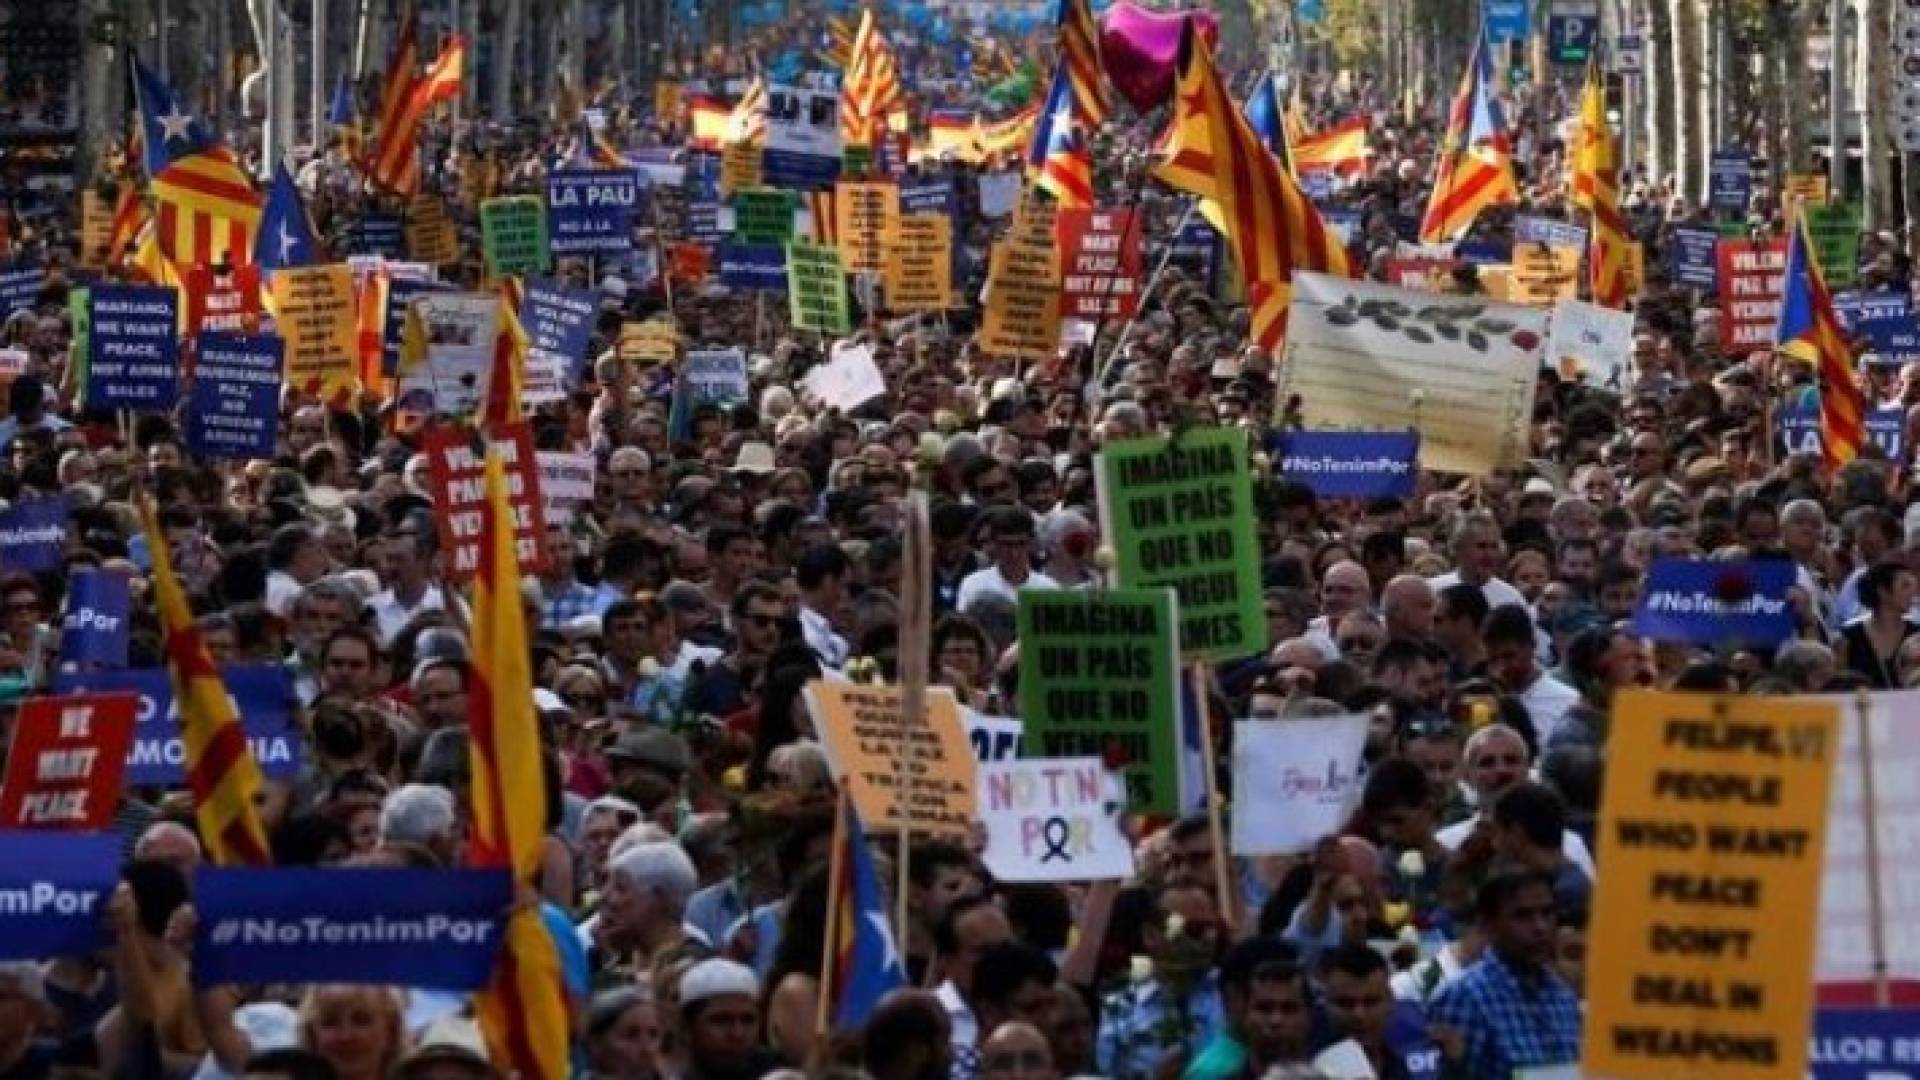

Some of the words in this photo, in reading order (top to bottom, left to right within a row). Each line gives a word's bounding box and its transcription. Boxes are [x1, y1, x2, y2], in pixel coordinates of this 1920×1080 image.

[551, 184, 579, 206] LA
[587, 184, 636, 205] PAU
[96, 321, 119, 335] WE
[123, 321, 170, 336] WANT
[1119, 442, 1236, 488] IMAGINA
[1281, 455, 1410, 474] #NoTenimPor
[1130, 494, 1169, 532] UN
[1172, 480, 1234, 525] PAÍS
[1139, 534, 1192, 574] QUE
[1197, 527, 1235, 564] NO
[1032, 604, 1156, 635] IMAGINA
[1039, 647, 1079, 677] UN
[1089, 641, 1152, 678] PAÍS
[58, 706, 95, 738] WE
[1047, 690, 1103, 722] QUE
[1109, 690, 1147, 722] NO
[1663, 718, 1785, 757] FELIPE,
[38, 748, 99, 781] WANT
[1654, 770, 1783, 806] PEOPLE
[1616, 820, 1698, 852] WHO
[1706, 827, 1810, 860] WANT
[1651, 873, 1762, 909] PEACE
[210, 915, 495, 946] #NoTenimPor
[1649, 923, 1752, 960] DON'T
[1633, 974, 1720, 1011] DEAL
[1726, 982, 1763, 1012] IN
[1612, 1023, 1779, 1067] WEAPONS
